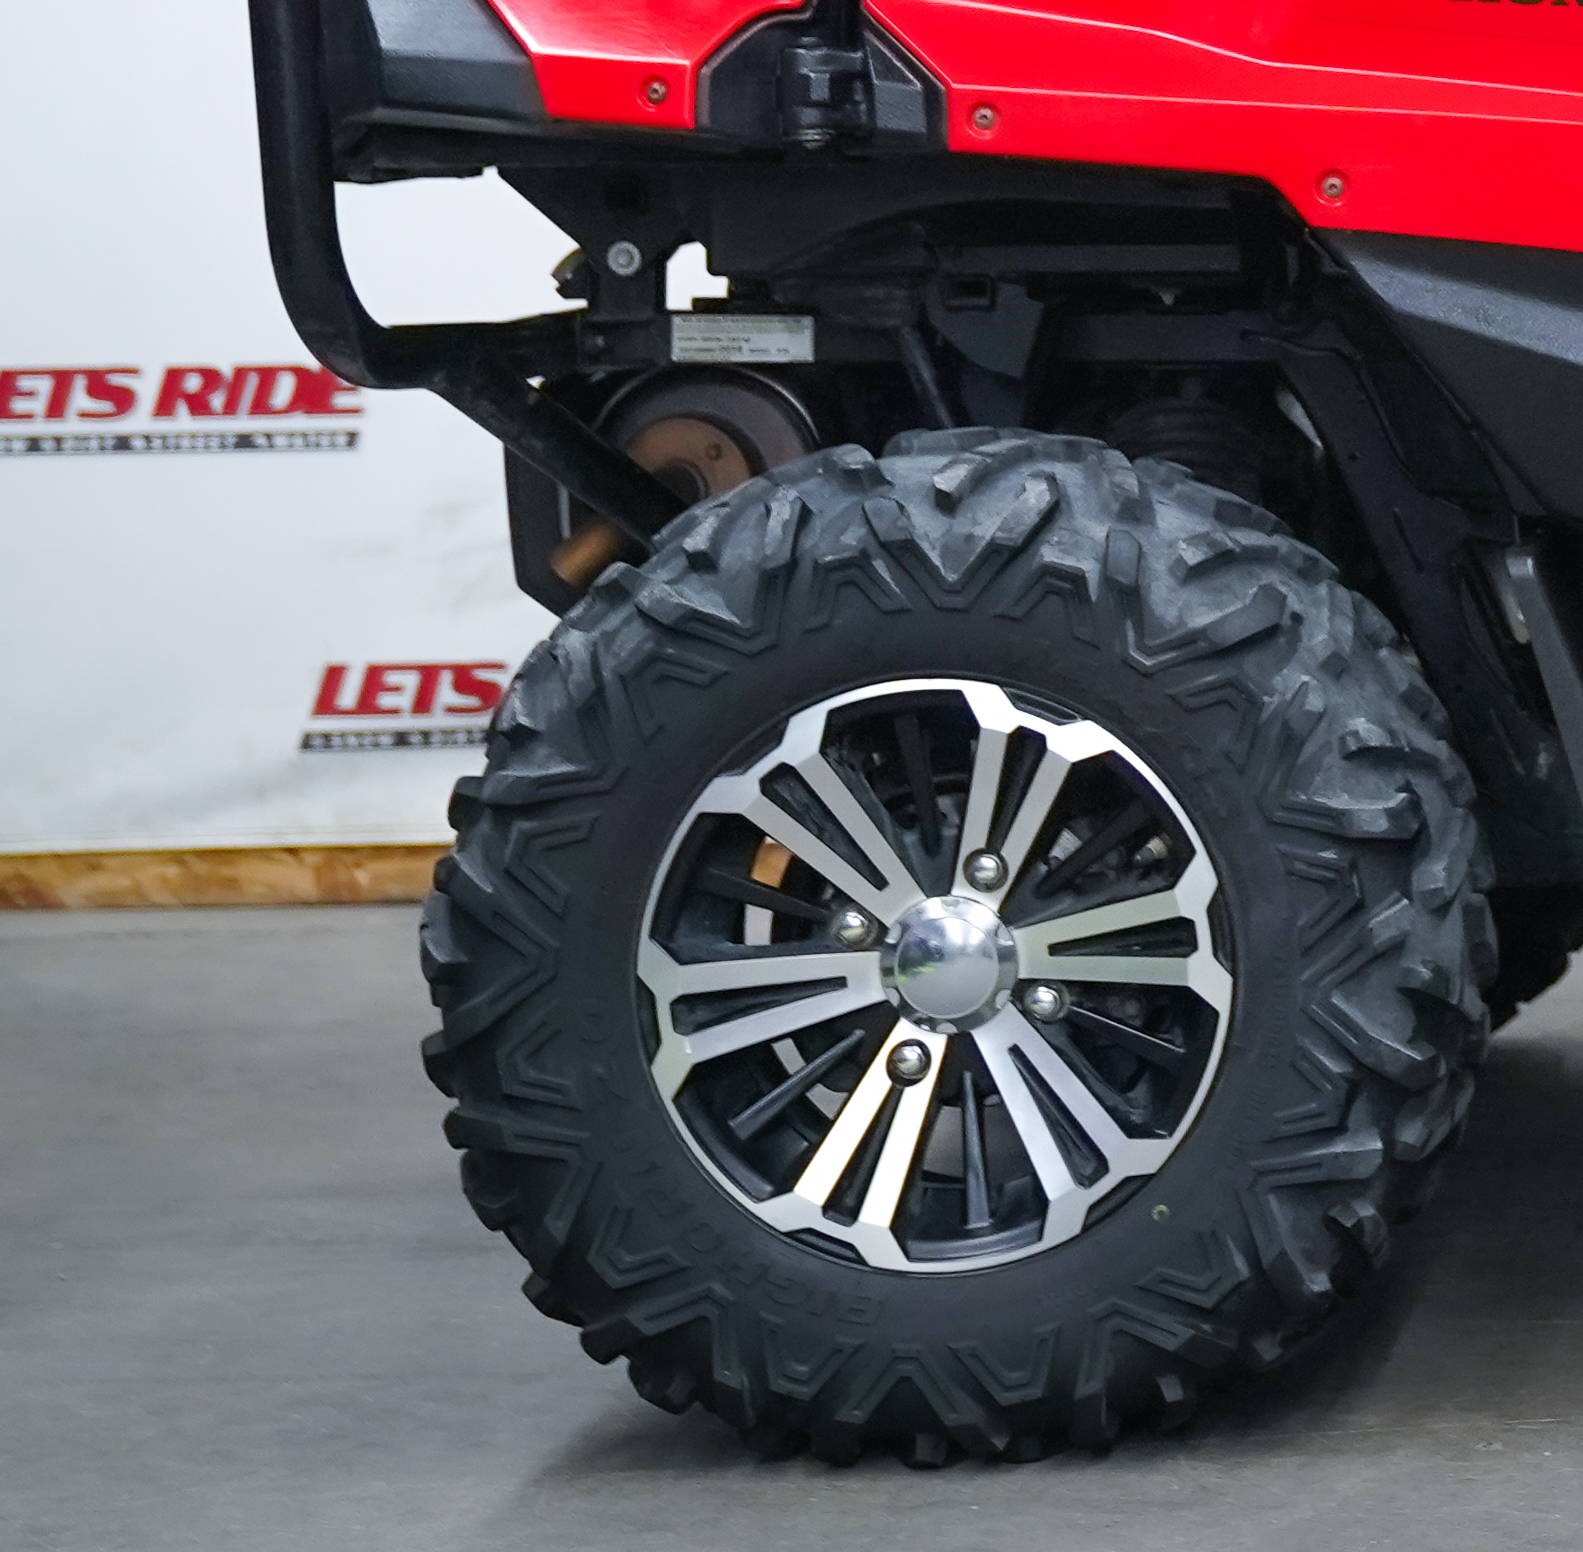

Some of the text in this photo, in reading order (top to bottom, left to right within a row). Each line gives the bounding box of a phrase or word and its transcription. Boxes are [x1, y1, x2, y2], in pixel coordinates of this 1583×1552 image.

[0, 366, 363, 420] ETS RIDE
[311, 663, 506, 716] LETS
